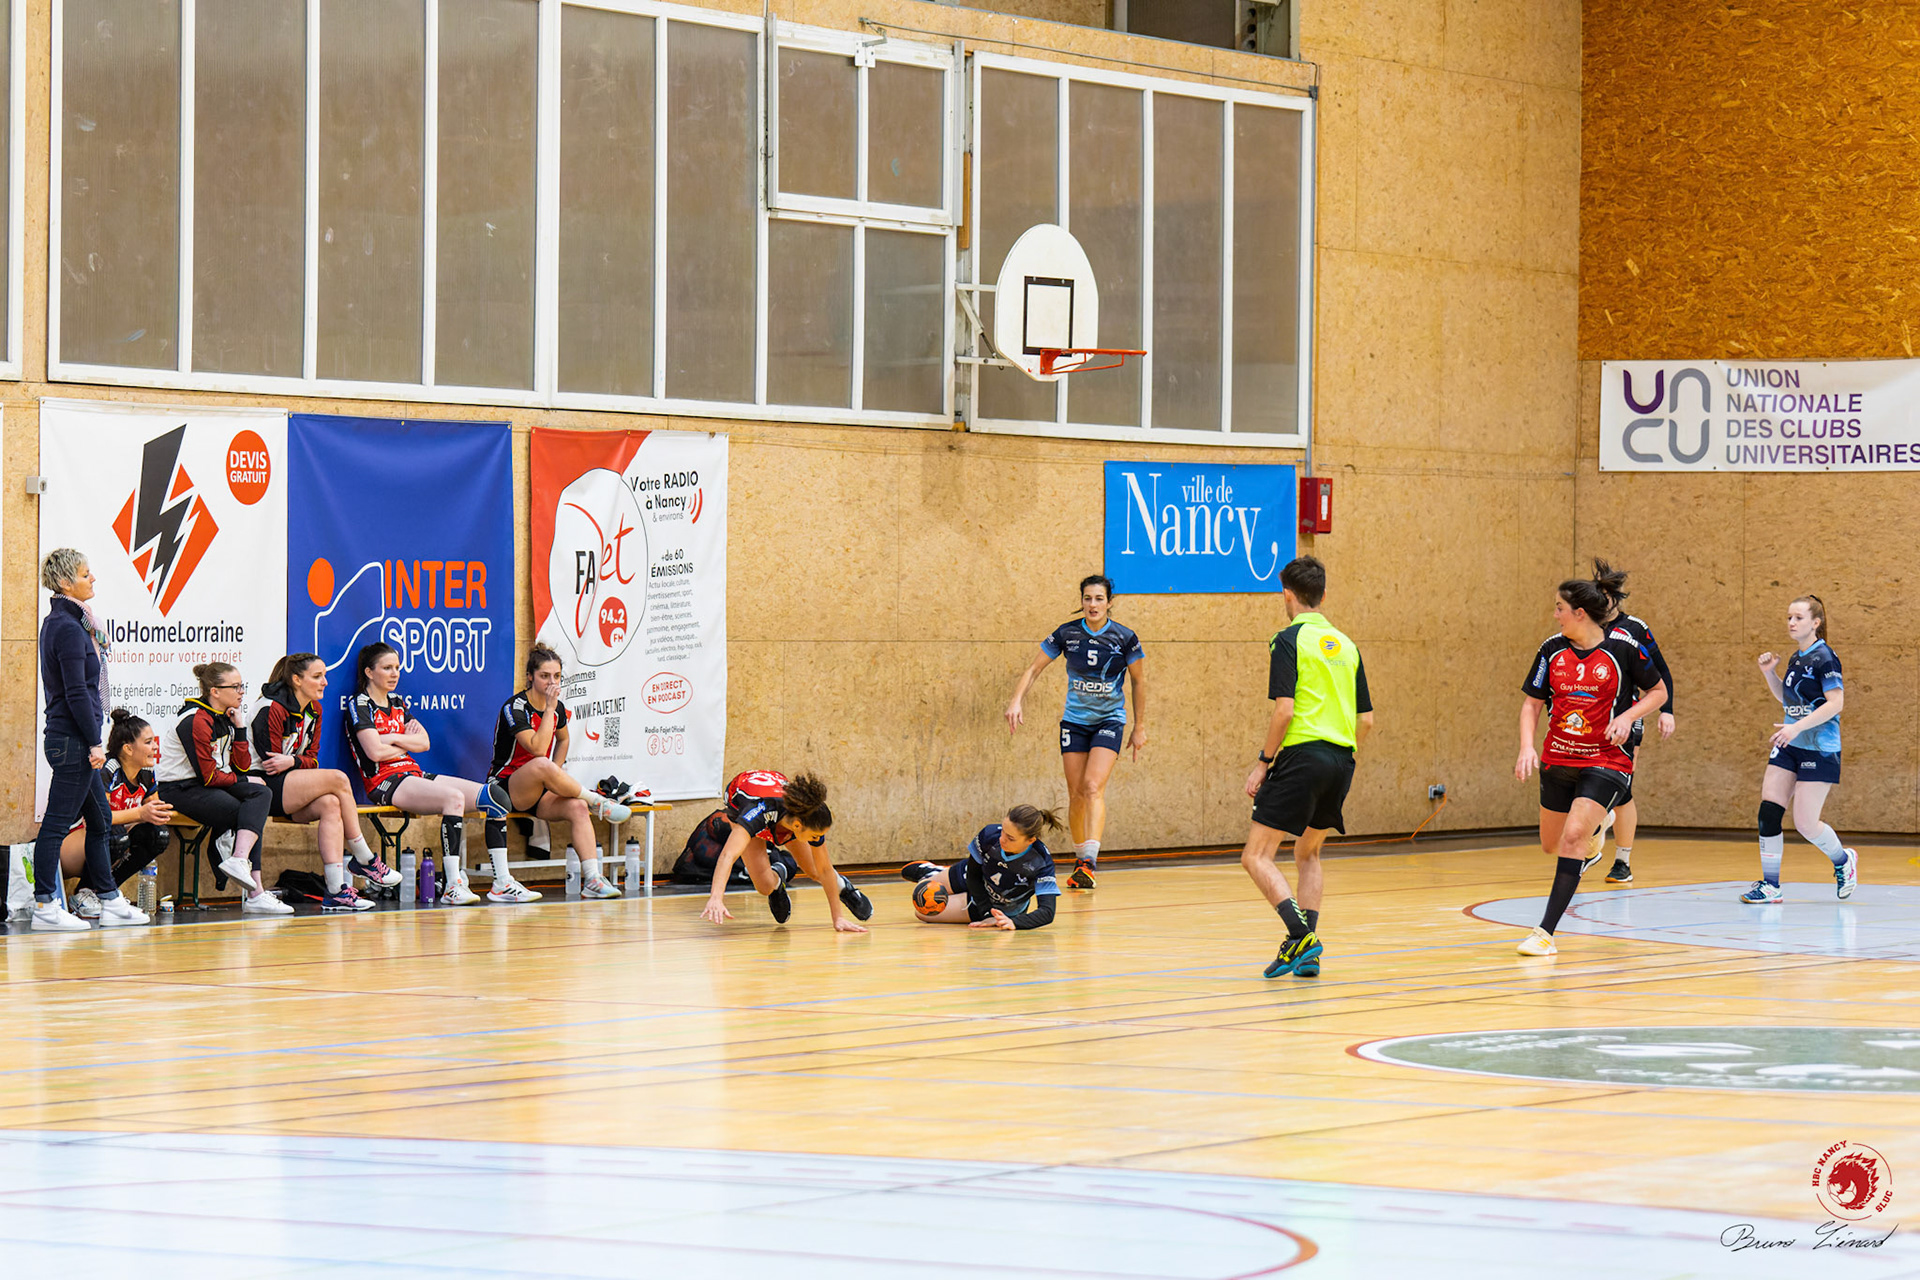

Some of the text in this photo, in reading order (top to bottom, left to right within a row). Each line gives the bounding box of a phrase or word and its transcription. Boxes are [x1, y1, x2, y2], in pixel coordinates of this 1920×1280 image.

[1726, 369, 1800, 388] UNION
[1726, 394, 1862, 413] NATIONALE
[1726, 419, 1861, 438] DES CLUBS
[230, 450, 267, 469] DEVIS
[1725, 443, 1920, 464] UNIVERSITAIRES
[230, 470, 267, 483] GRATUIT
[630, 470, 699, 492] Votre RADIO
[1182, 475, 1233, 503] ville de
[646, 494, 686, 511] à Nancy
[653, 512, 684, 523] & environs
[1121, 472, 1278, 581] Nancy
[675, 548, 684, 560] 60
[651, 562, 694, 577] ÉMISSIONS
[385, 559, 487, 609] INTER
[600, 609, 625, 624] 94.2
[106, 619, 244, 643] lloHomeLorraine
[613, 634, 624, 643] FM
[381, 617, 492, 673] SPORT
[106, 650, 144, 664] olution
[149, 652, 175, 665] pour
[179, 651, 207, 663] votre
[1088, 650, 1098, 666] 5
[1785, 671, 1795, 687] 6
[124, 684, 162, 700] générale
[171, 684, 200, 700] Dépan
[648, 690, 686, 704] EN PODCAST
[652, 684, 660, 693] EN
[1560, 683, 1599, 694] Guy Hoquet
[574, 697, 625, 720] WWW.FAJET.NET
[1062, 728, 1071, 747] 5
